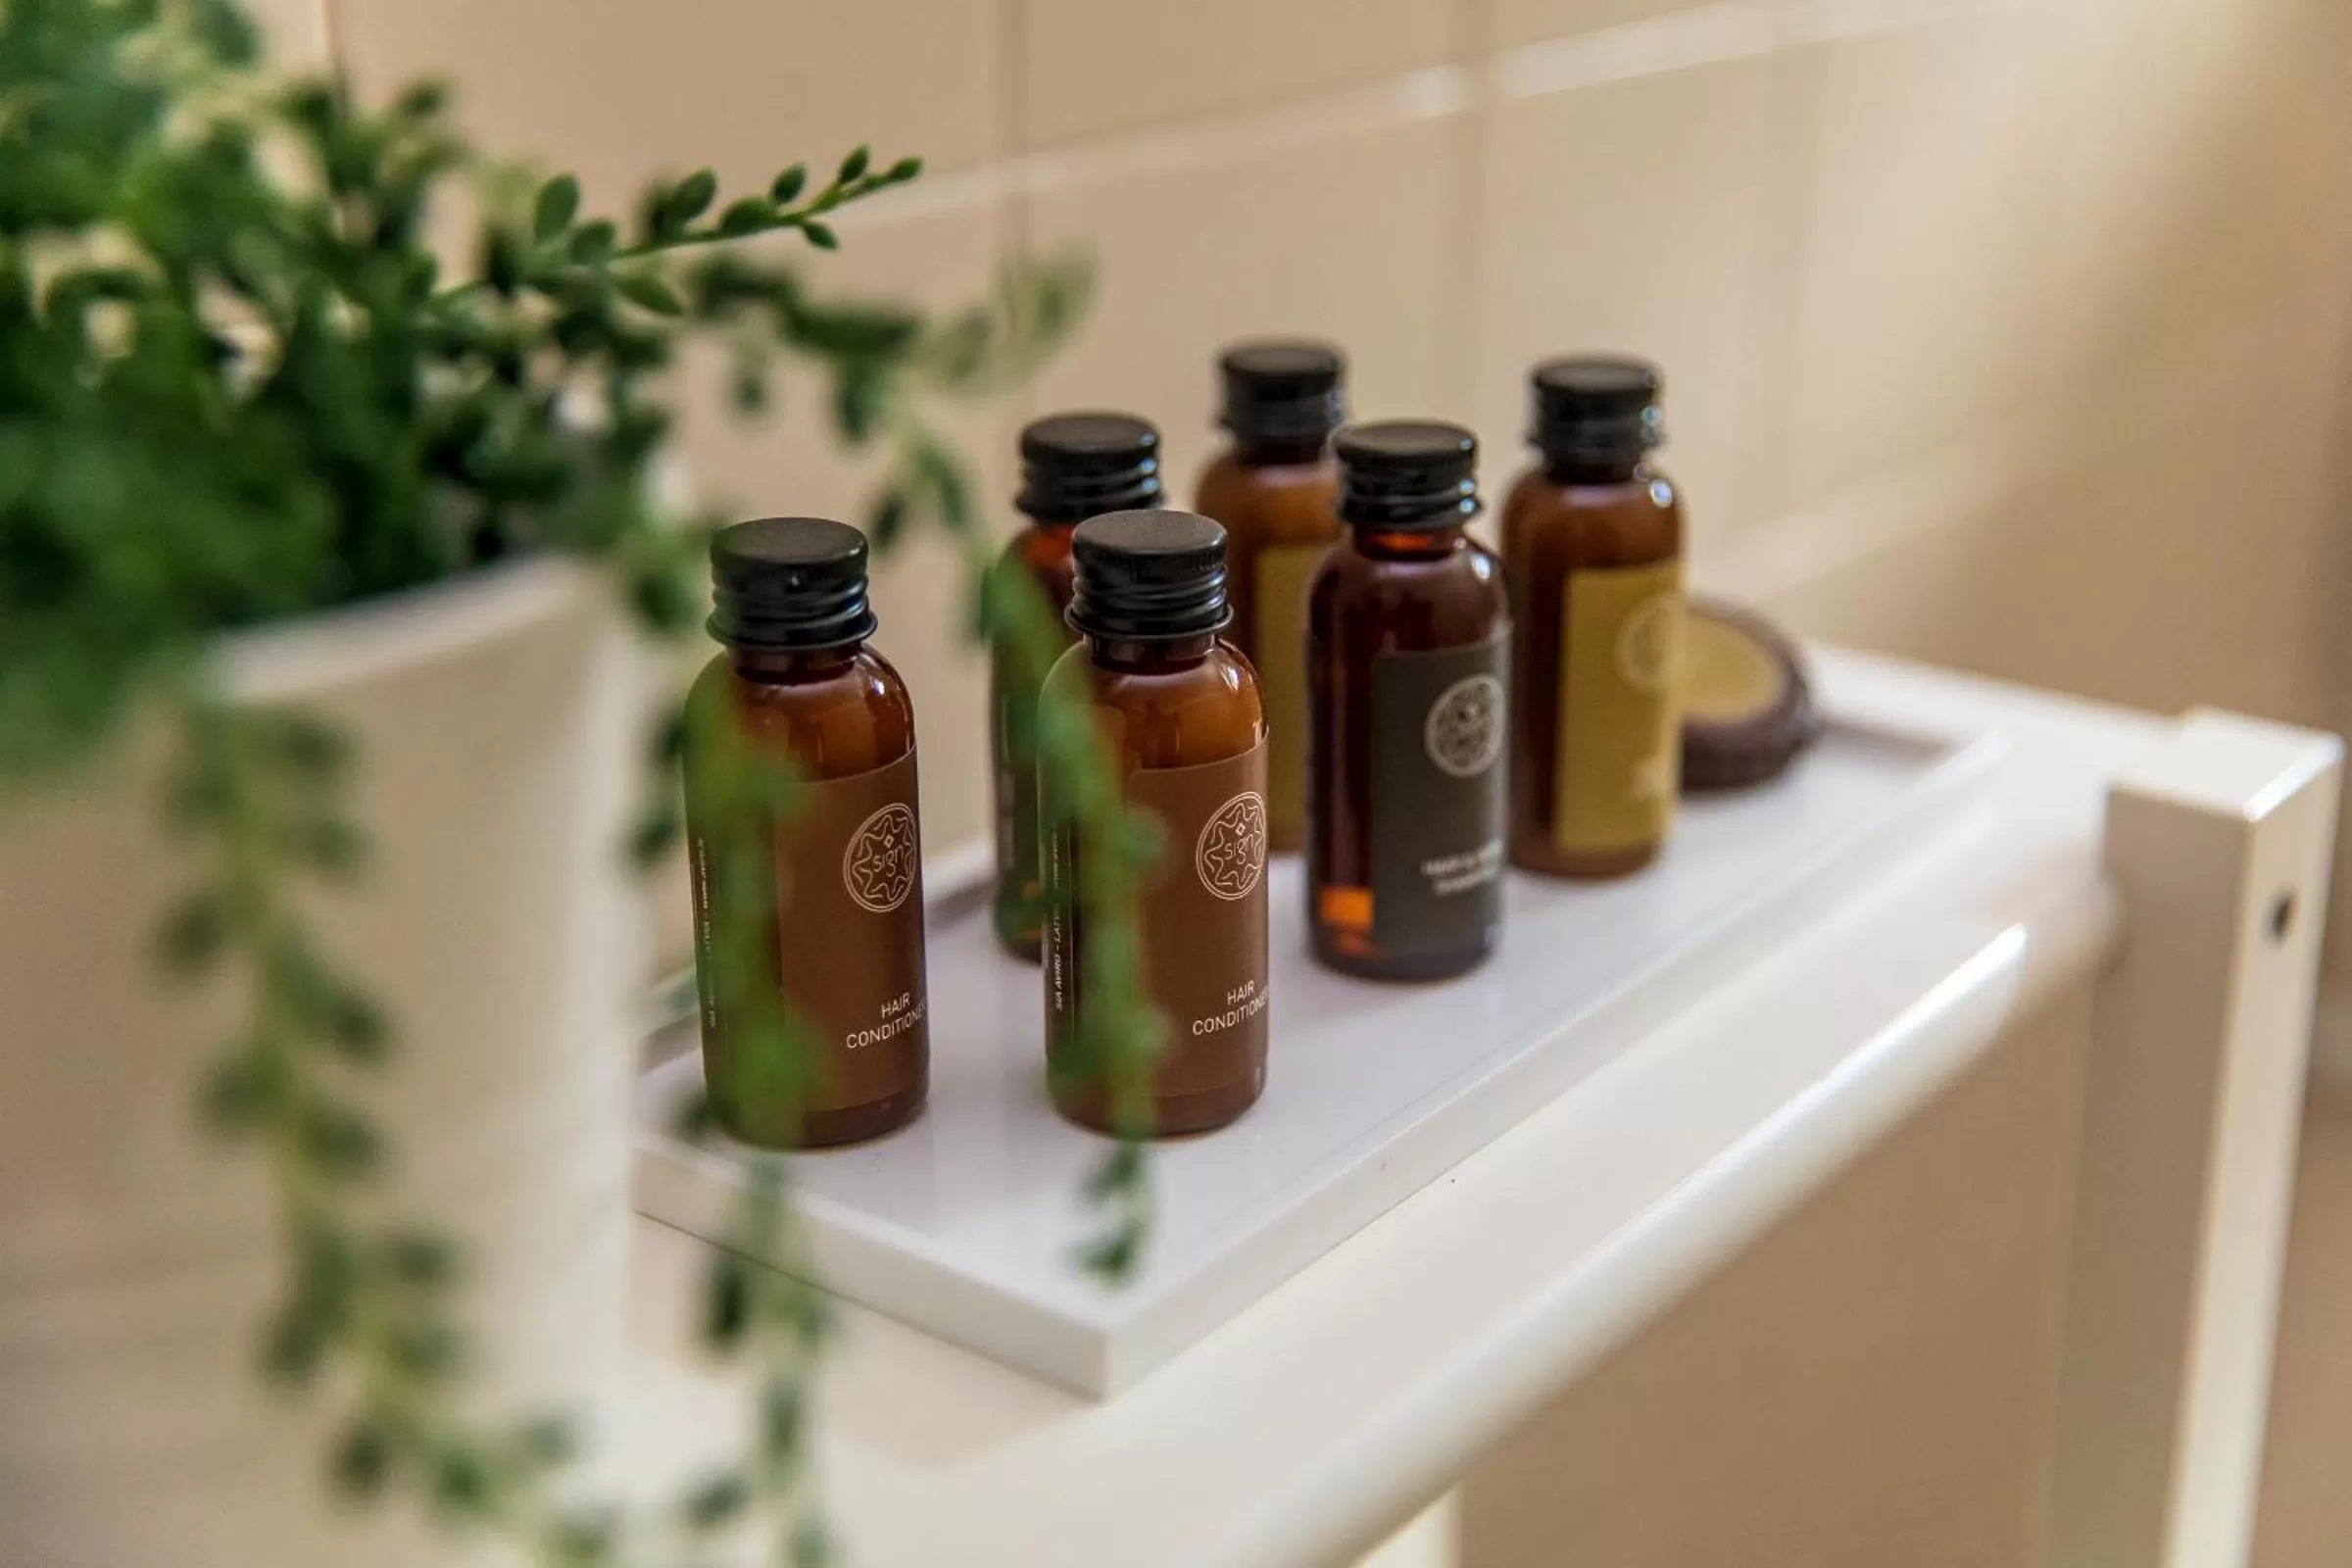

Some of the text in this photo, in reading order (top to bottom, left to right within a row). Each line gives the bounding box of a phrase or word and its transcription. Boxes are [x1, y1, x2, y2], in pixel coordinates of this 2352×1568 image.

[873, 845, 904, 877] sign
[881, 991, 910, 1020] HAIR
[1227, 980, 1255, 1005] HAIR
